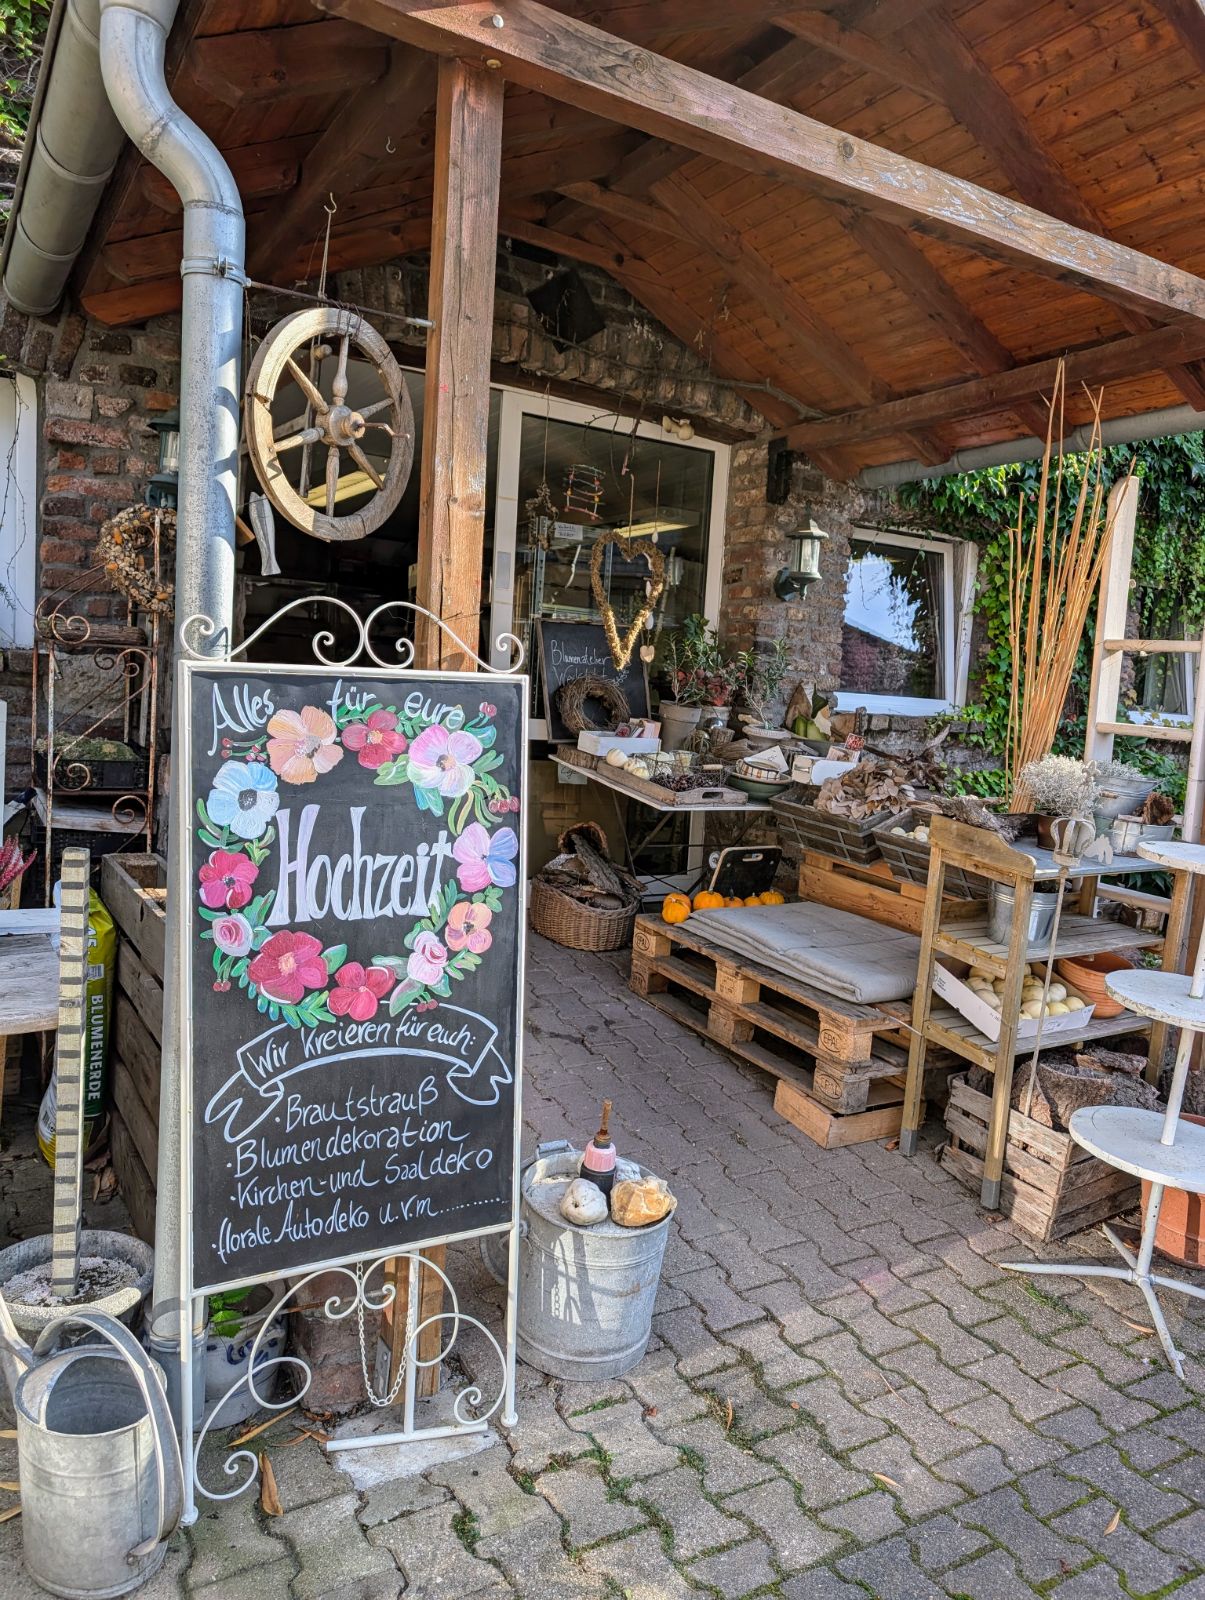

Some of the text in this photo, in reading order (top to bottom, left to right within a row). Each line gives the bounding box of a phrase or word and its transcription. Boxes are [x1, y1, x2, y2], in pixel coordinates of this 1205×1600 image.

[208, 678, 465, 756] Alles für eure
[265, 804, 453, 926] Hochzeit
[88, 994, 104, 1102] BLUMENERDE
[247, 1037, 290, 1078] Wir
[395, 1008, 427, 1046] für
[427, 1020, 476, 1055] euch:
[285, 1075, 439, 1133] Brautstrauß
[234, 1119, 470, 1178] Blumendekoration
[217, 1217, 272, 1264] florale
[273, 1200, 369, 1243] Autodeko
